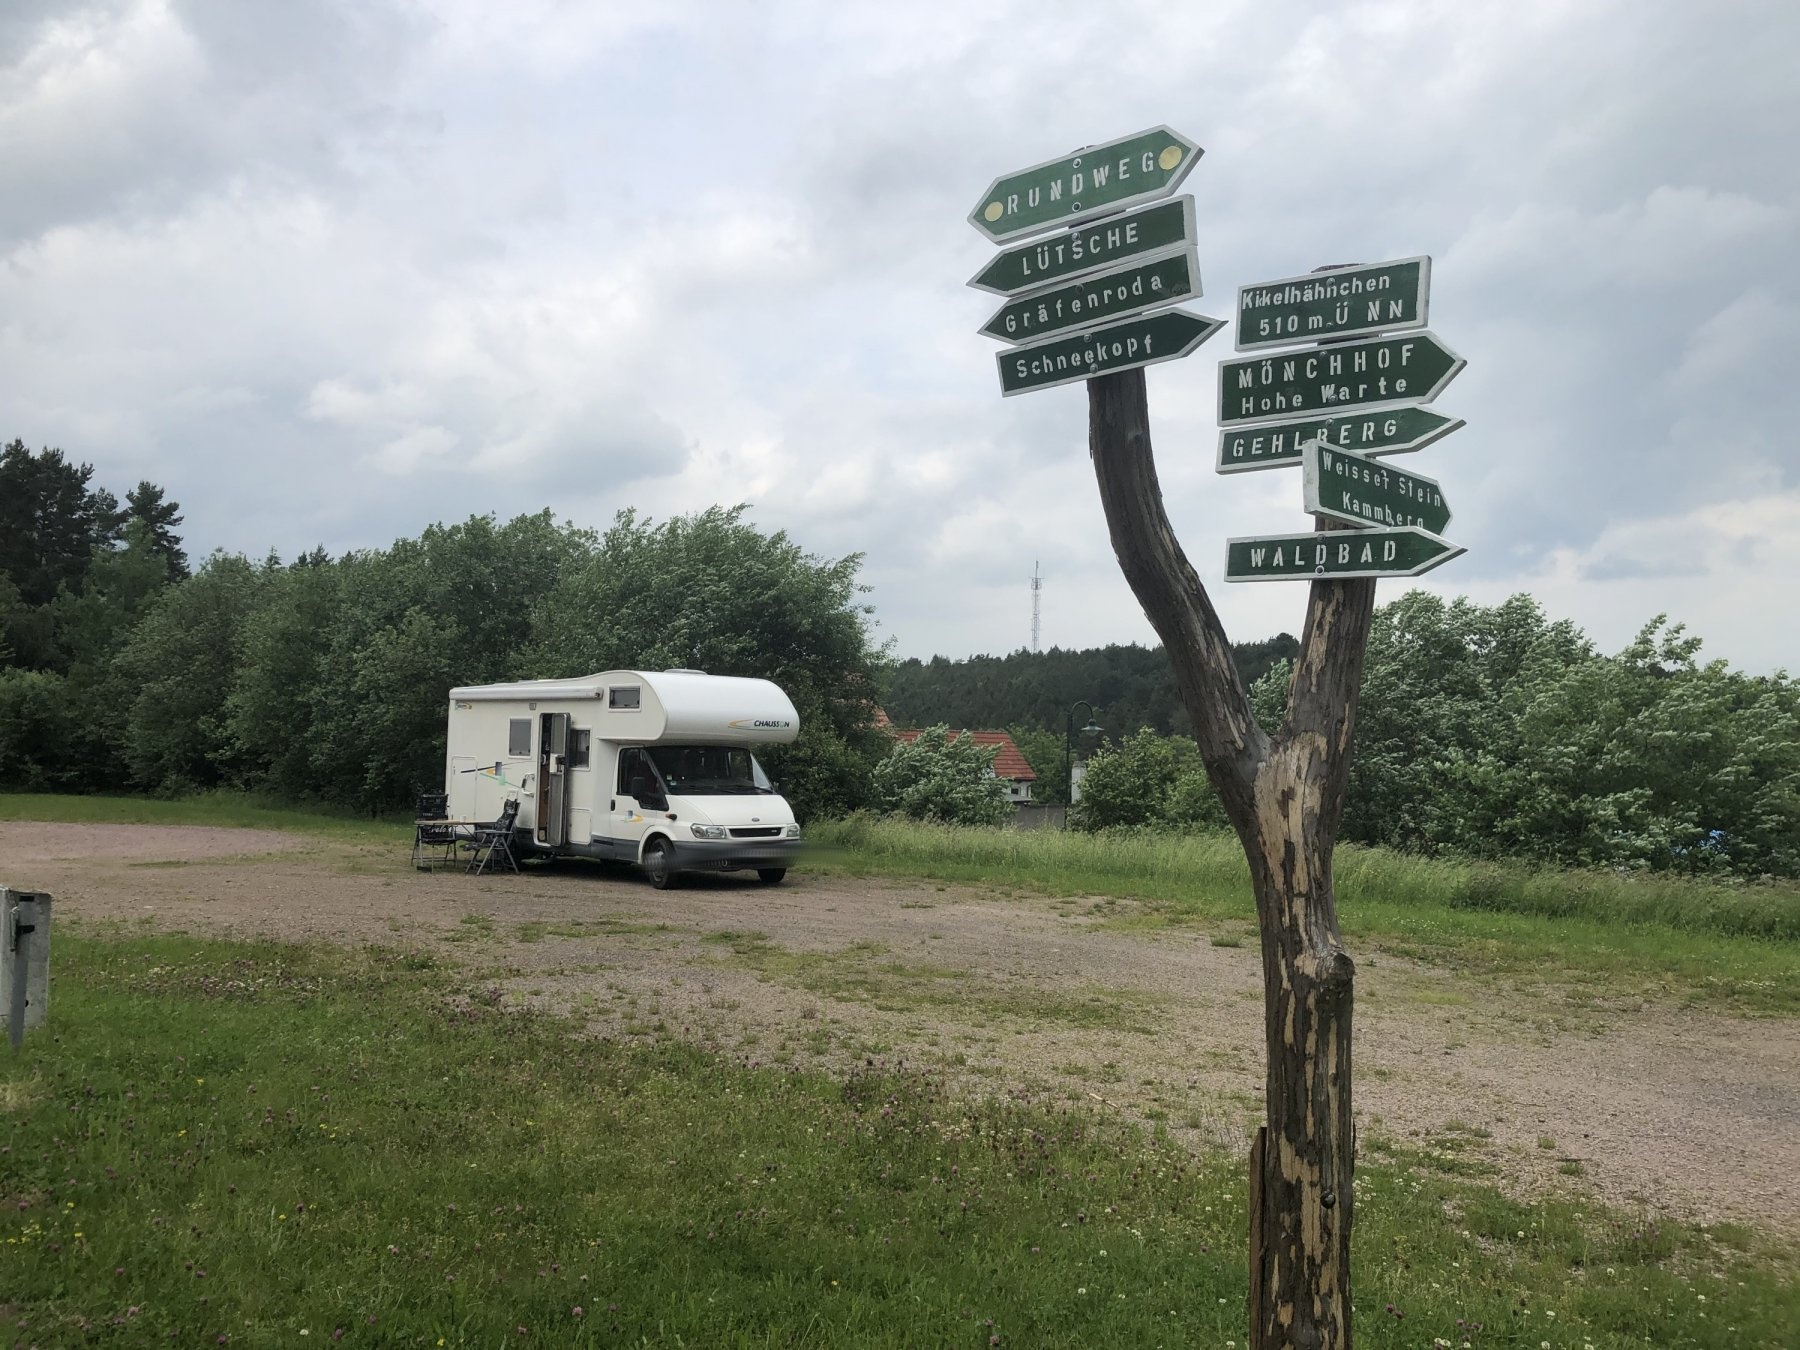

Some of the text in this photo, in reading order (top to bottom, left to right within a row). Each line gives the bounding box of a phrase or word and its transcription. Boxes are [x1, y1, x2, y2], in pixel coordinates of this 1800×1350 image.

[1007, 151, 1154, 215] RUNDWEG
[1022, 222, 1139, 276] LÜTSCHE
[1005, 274, 1163, 333] Gräfenroda
[1242, 275, 1391, 310] Kikelhähnchen
[1260, 314, 1299, 336] 510
[1335, 301, 1348, 325] Ü
[1016, 334, 1152, 378] Schneekopf
[1238, 344, 1414, 389] MÖNCHHOF
[1241, 377, 1407, 415] Hohe Warte
[1233, 419, 1397, 457] GEHLBERG
[1399, 477, 1441, 507] Stein
[1251, 541, 1396, 568] WALDBAD
